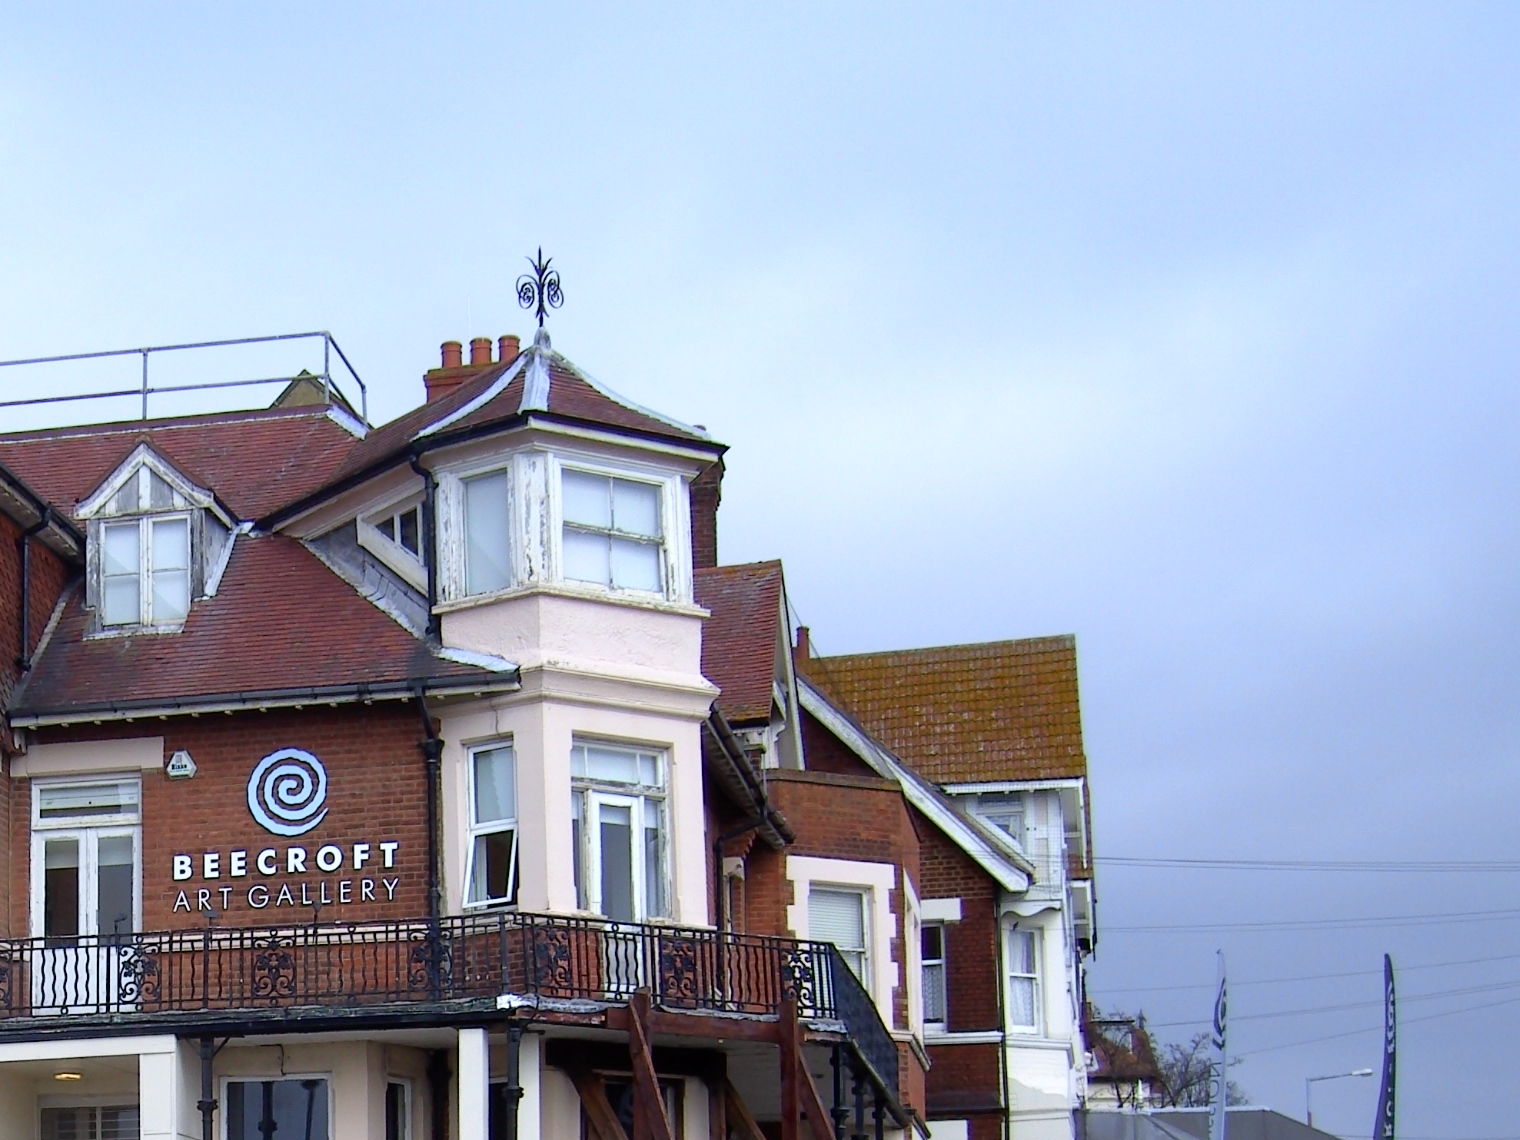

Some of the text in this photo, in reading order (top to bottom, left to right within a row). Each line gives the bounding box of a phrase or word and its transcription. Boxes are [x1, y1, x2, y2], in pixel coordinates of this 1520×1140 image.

[172, 842, 399, 880] BEECROFT
[173, 878, 399, 913] ART GALLERY
